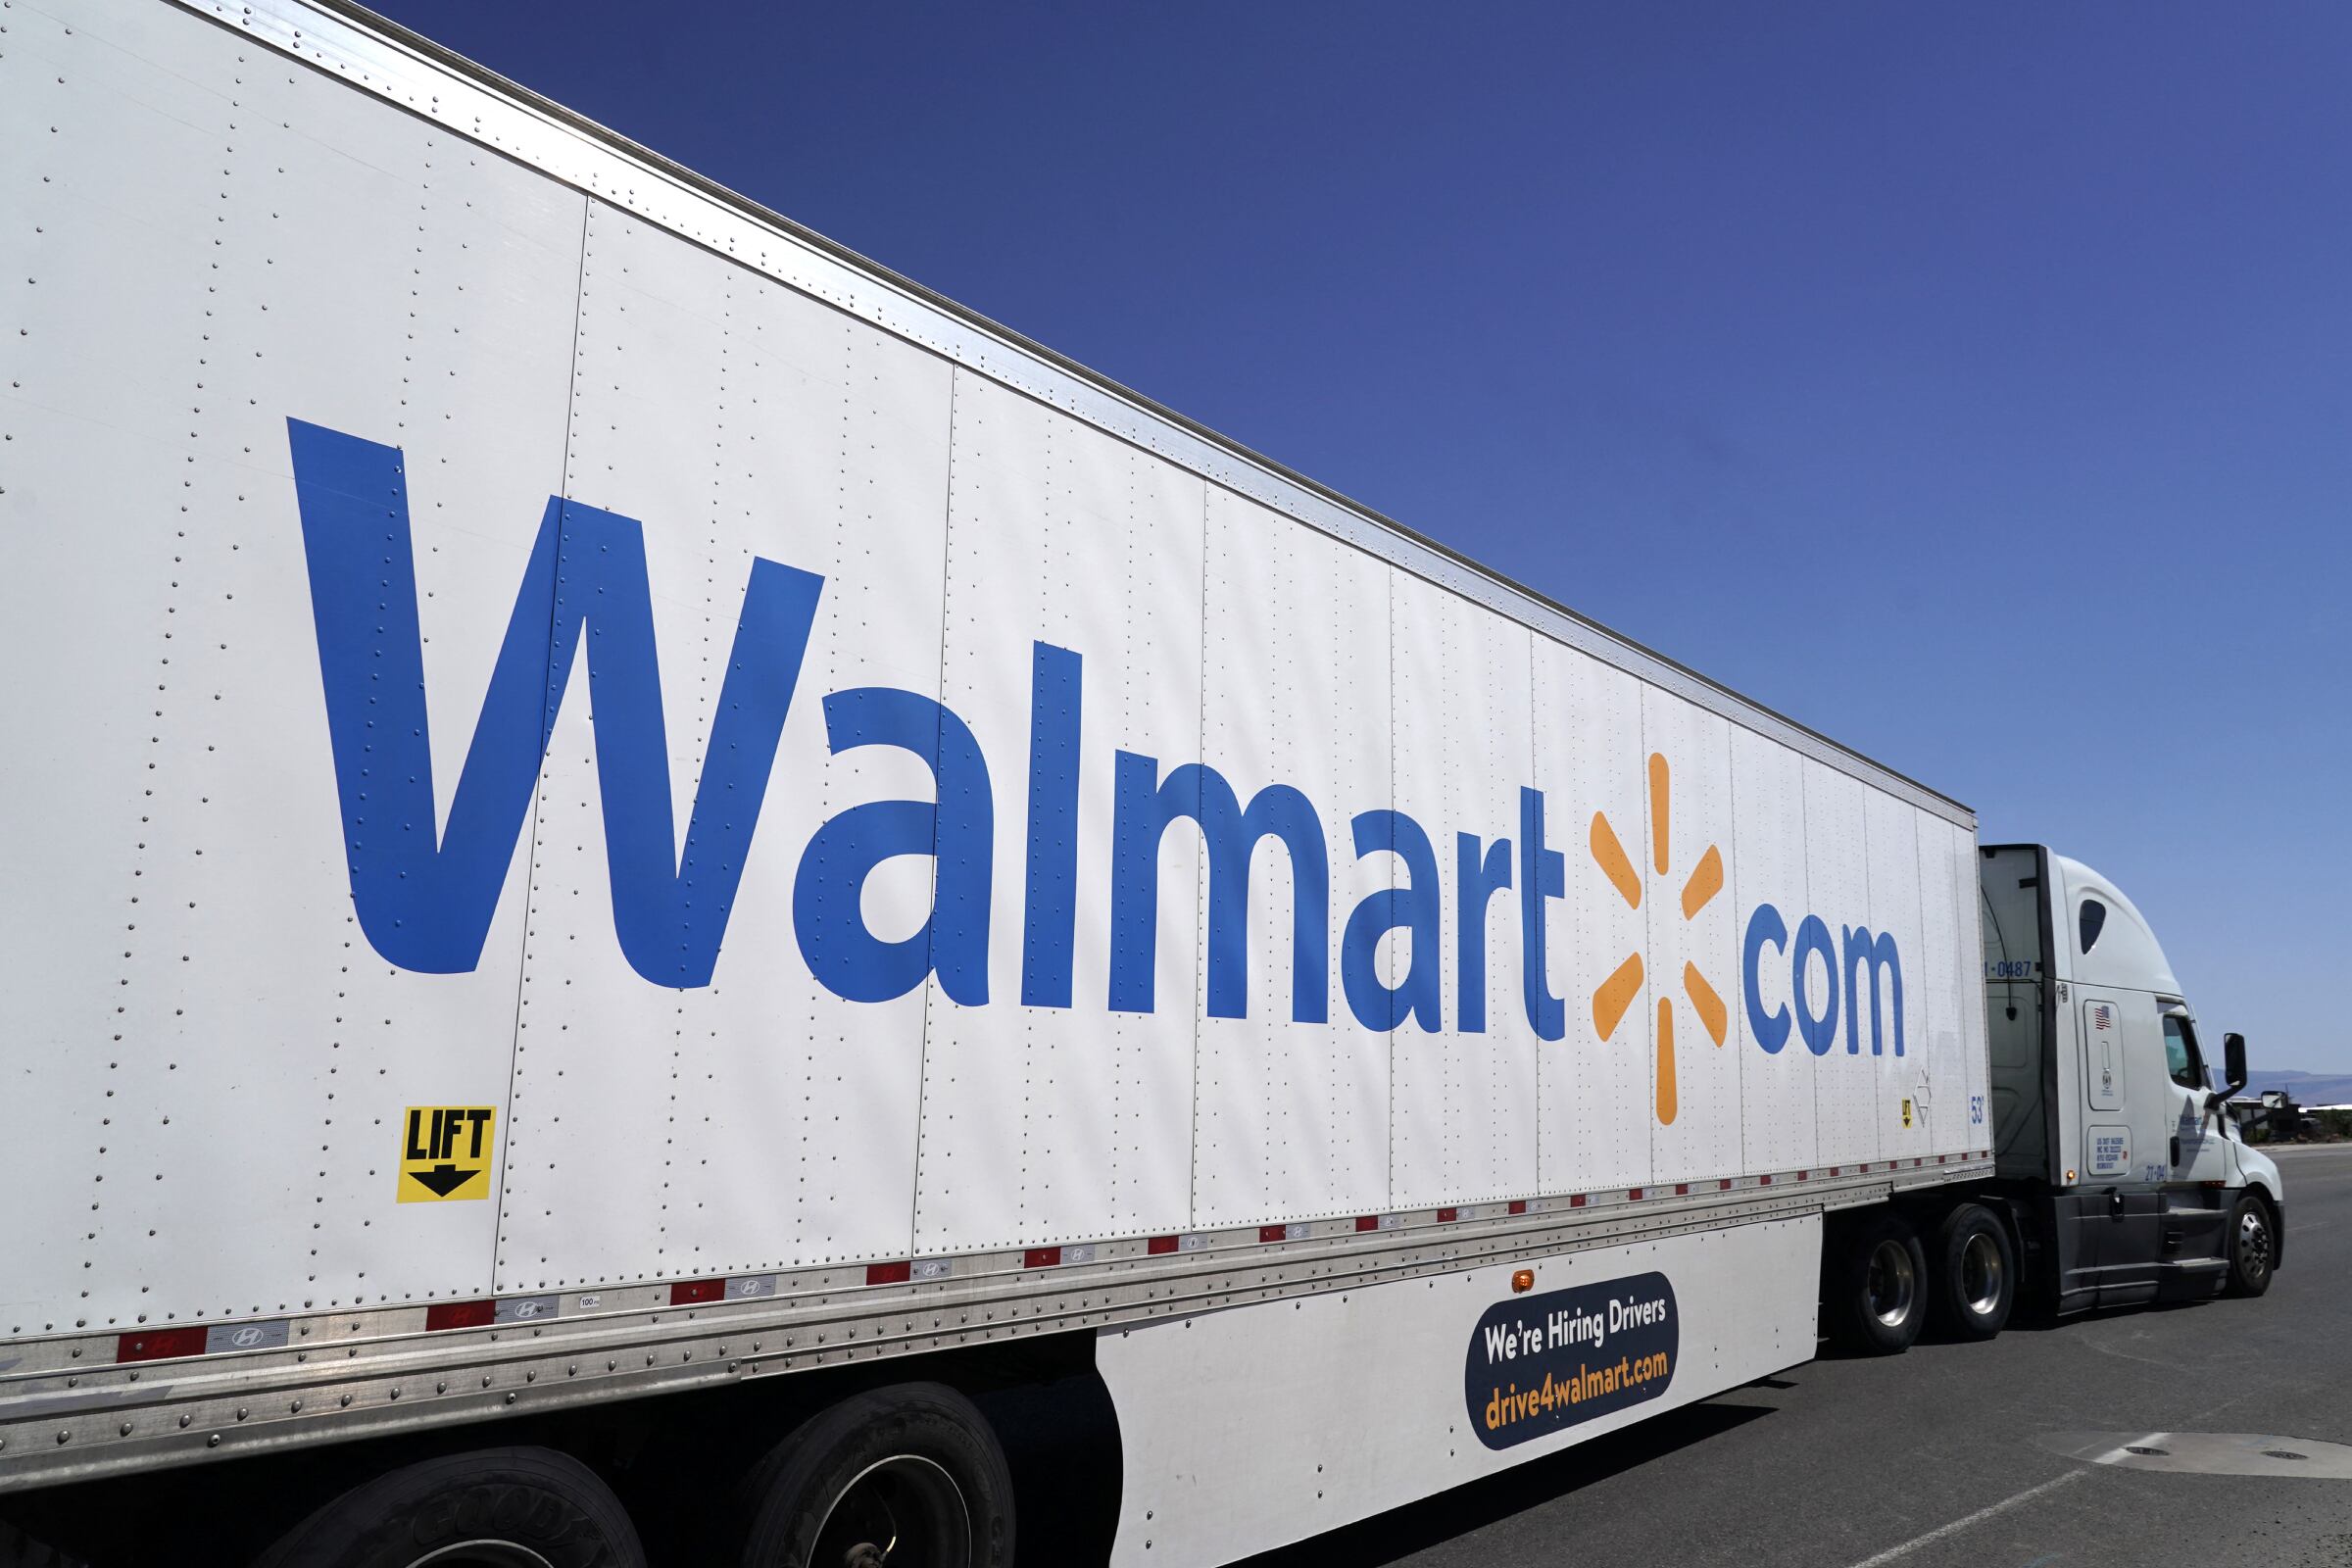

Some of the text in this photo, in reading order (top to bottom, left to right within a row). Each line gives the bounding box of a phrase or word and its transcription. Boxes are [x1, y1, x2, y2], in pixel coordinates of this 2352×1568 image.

[286, 416, 1566, 1042] Walmart
[406, 1108, 492, 1160] LIFT
[1484, 1296, 1666, 1365] We're Hiring Drivers
[1486, 1350, 1668, 1431] drive4walmart.com
